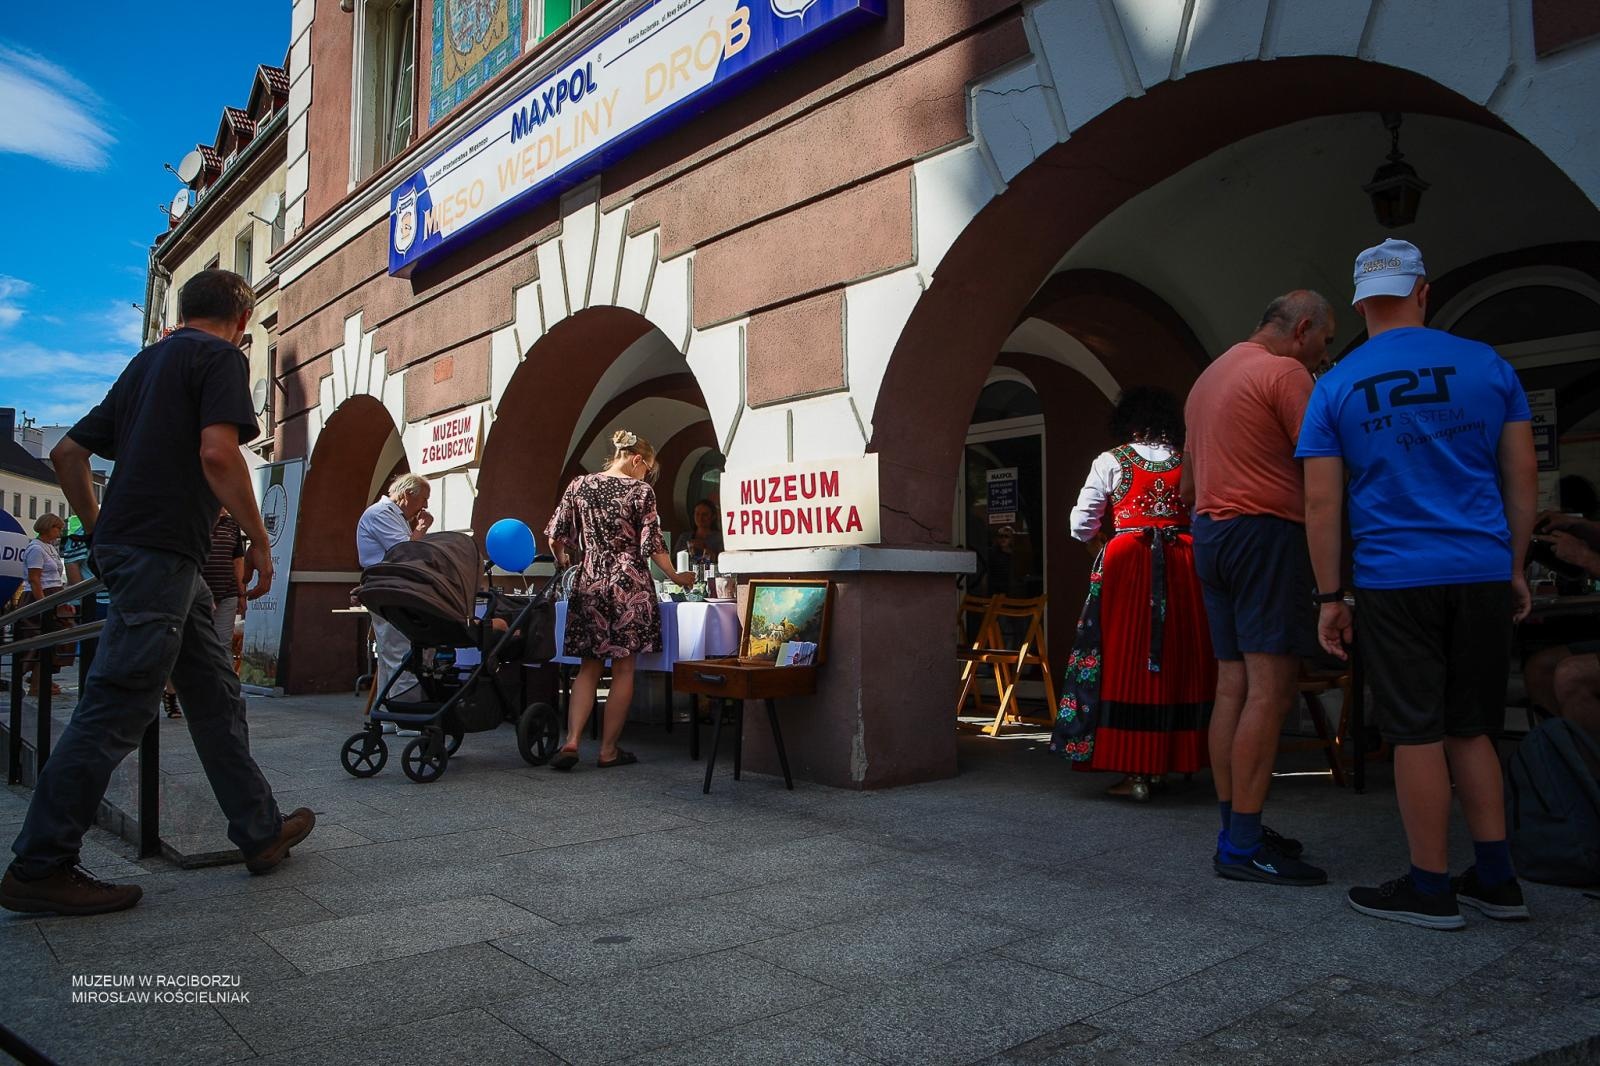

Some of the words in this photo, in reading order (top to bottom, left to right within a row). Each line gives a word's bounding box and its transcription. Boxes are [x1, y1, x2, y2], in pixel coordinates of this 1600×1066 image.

[510, 61, 598, 144] MAXPOL
[423, 178, 484, 243] MIĘSO
[497, 87, 620, 192] WĘDLINY
[644, 5, 751, 105] DRÓB
[1353, 366, 1457, 413] T2T
[432, 415, 472, 443] MUZEUM
[1361, 414, 1393, 434] T2T
[1399, 407, 1465, 426] SYSTEM
[421, 447, 429, 465] Z
[429, 436, 474, 462] GŁUBCZYC
[740, 470, 840, 505] MUZEUM
[726, 511, 736, 536] Z
[740, 505, 863, 536] PRUDNIKA
